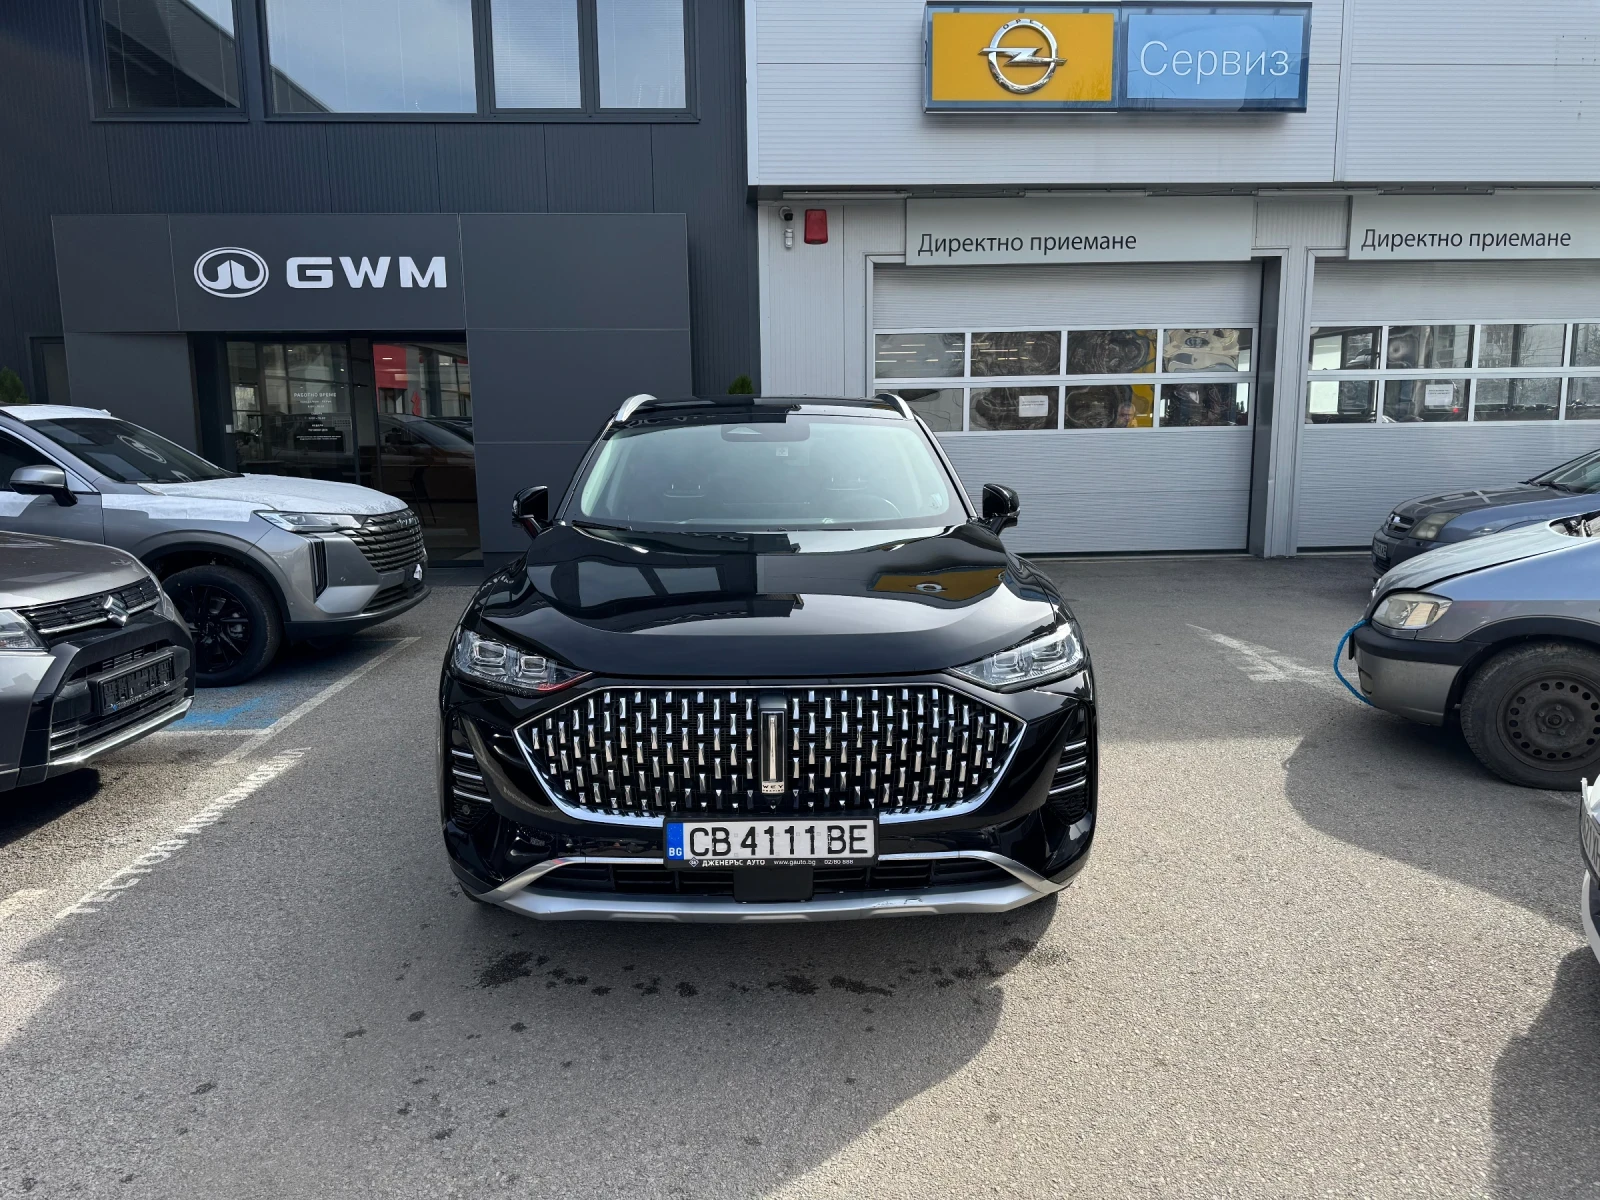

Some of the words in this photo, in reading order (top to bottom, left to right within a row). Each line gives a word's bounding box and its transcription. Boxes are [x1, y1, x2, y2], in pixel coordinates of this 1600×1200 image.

[1003, 18, 1046, 31] OPEL
[1140, 40, 1289, 85] Сервиз
[918, 233, 1024, 257] Директно
[1030, 235, 1137, 256] приемане
[1360, 228, 1463, 252] Директно
[1469, 232, 1572, 252] приемане
[286, 256, 447, 289] GWM
[668, 847, 683, 857] BG
